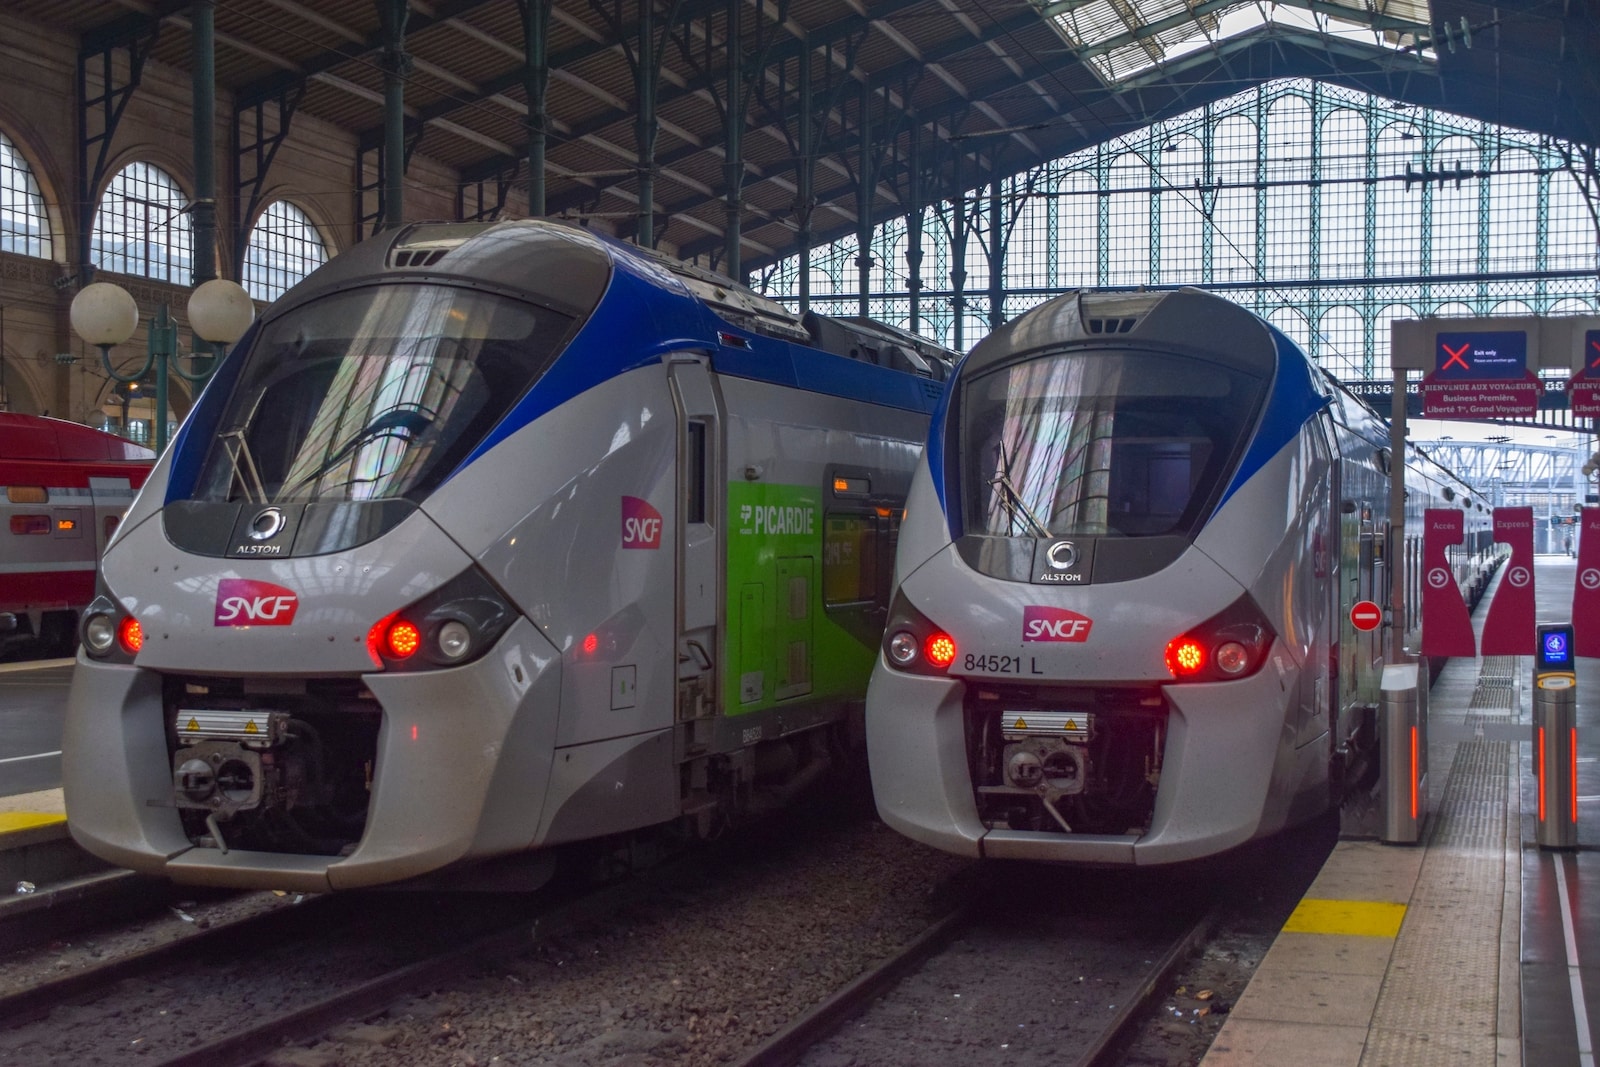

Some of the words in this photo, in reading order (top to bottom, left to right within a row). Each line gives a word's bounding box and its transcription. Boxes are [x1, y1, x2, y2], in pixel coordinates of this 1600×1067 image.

[1427, 405, 1456, 413] Liberté
[1470, 405, 1495, 413] Grand
[1495, 405, 1534, 413] Voyageur
[1575, 404, 1600, 412] Libert
[755, 505, 814, 534] PICARDIE
[1496, 520, 1530, 529] Express
[623, 517, 661, 543] SNCF
[236, 545, 281, 554] ALSTOM
[1040, 573, 1081, 582] ALSTOM
[218, 596, 297, 621] SNCF
[1025, 619, 1089, 638] SNCF
[964, 653, 1021, 674] 84521
[1031, 656, 1043, 675] L
